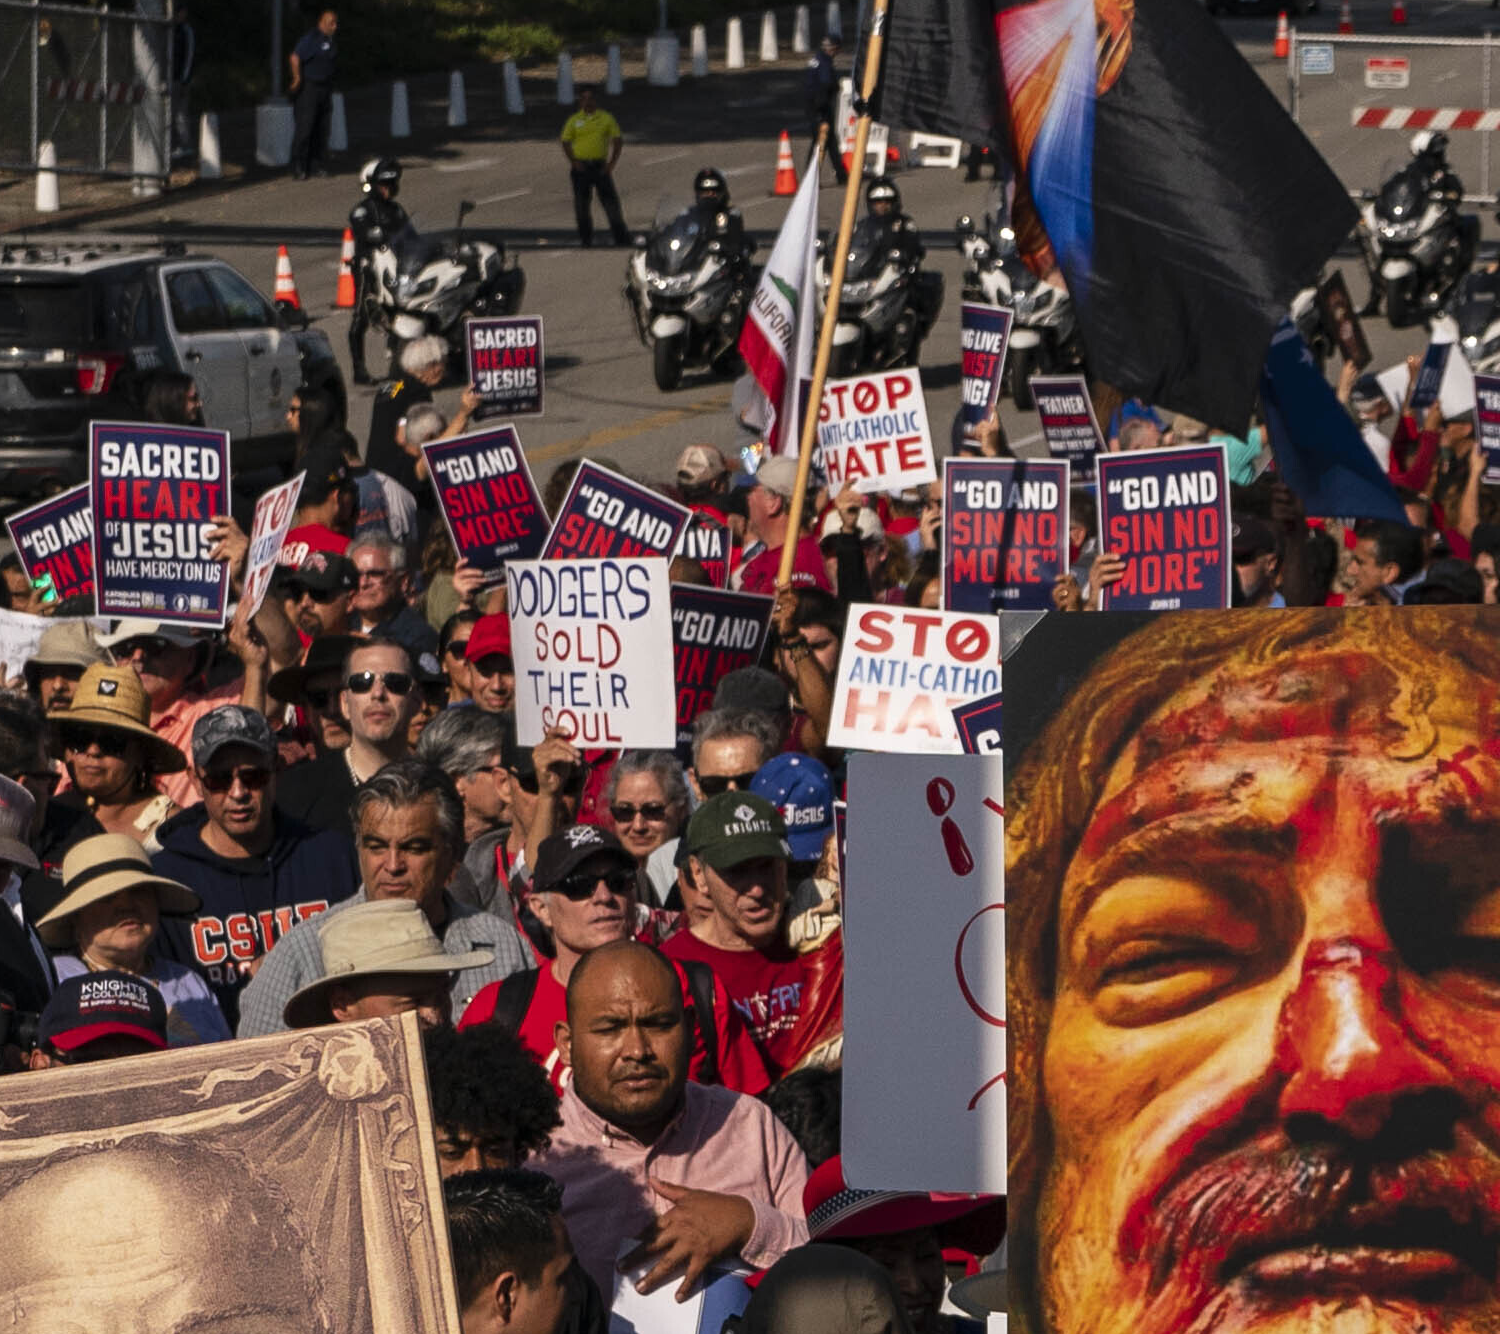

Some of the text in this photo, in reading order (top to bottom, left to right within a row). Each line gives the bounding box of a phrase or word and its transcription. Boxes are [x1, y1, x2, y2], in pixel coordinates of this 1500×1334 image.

[474, 327, 537, 349] SACRED
[476, 348, 536, 369] HEART
[486, 368, 537, 391] JESUS
[817, 374, 913, 421] STOP
[821, 410, 920, 446] ANTI-CATHOLIC
[100, 442, 221, 481] SACRED
[435, 446, 519, 485] “GO AND
[823, 436, 928, 487] HATE
[103, 479, 221, 520] HEART
[445, 473, 530, 518] SIN NO
[953, 480, 1059, 510] “GO AND
[1107, 470, 1218, 511] “GO AND
[456, 504, 535, 549] MORE”
[559, 514, 615, 554] SIN
[580, 484, 673, 550] “GO AND
[952, 512, 1058, 546] SIN NO
[1109, 507, 1219, 553] SIN NO
[105, 521, 220, 560] OF JESUS
[105, 560, 222, 583] HAVE MERCY ON US
[953, 548, 1058, 585] MORE”
[1112, 550, 1220, 597] MORE”
[508, 560, 651, 622] DODGERS
[534, 621, 622, 669] SOLD
[673, 607, 760, 650] “GO AND
[854, 610, 1003, 664] STO
[849, 655, 999, 695] ANTI-CATHO
[542, 705, 623, 744] SOUL
[724, 819, 772, 837] KNIGHTS
[80, 979, 148, 999] KNIGHTS
